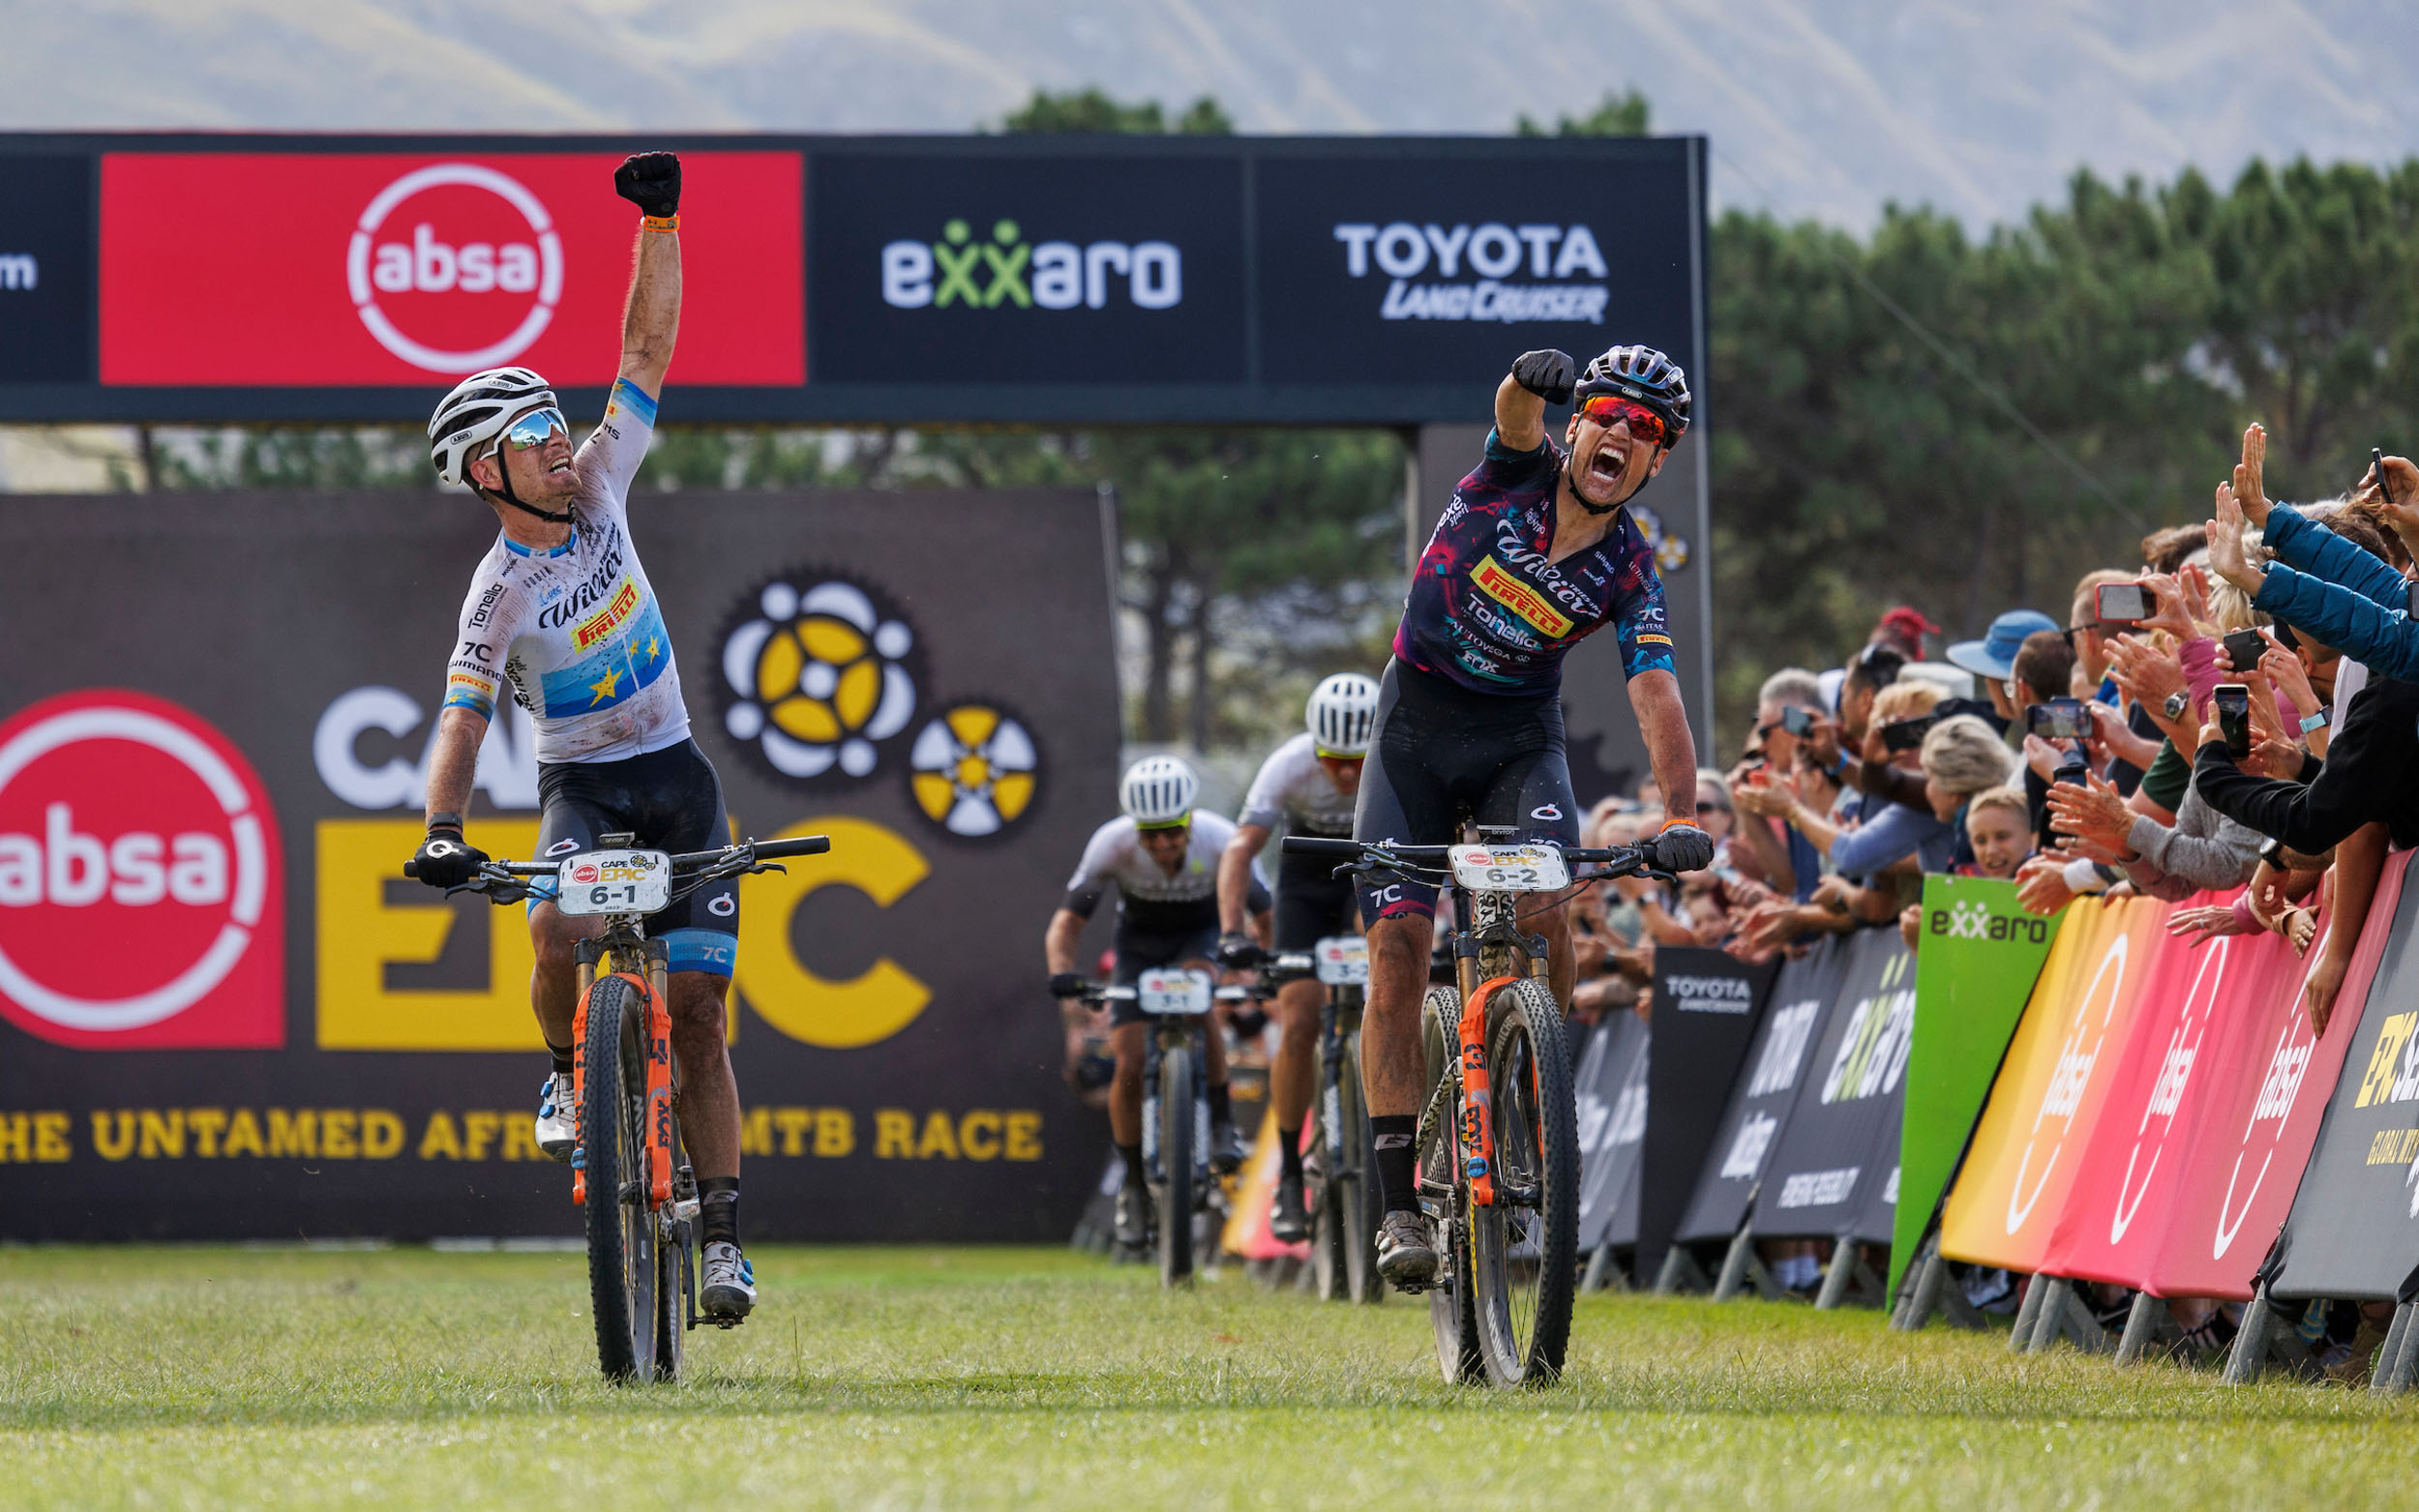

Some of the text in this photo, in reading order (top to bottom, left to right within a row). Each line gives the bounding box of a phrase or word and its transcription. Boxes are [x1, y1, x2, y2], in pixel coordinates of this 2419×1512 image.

[373, 222, 538, 293] absa
[881, 219, 1182, 310] exxaro
[1333, 221, 1609, 279] TOYOTA
[453, 432, 471, 444] ABUS
[538, 528, 623, 629] Wilier
[1479, 566, 1564, 634] PIRELLI
[467, 582, 503, 629] Tonello
[578, 584, 636, 647] PIRELLI
[1468, 593, 1539, 648] Tonello
[1639, 608, 1664, 622] 7C
[463, 641, 493, 664] 7C
[1450, 621, 1511, 661] AUTOVEGA
[449, 660, 503, 681] IMANO
[314, 685, 539, 810] CA
[0, 802, 228, 908] absa
[577, 870, 595, 878] absa
[600, 868, 647, 882] EPIC
[601, 860, 629, 869] CAPE
[1486, 868, 1539, 883] 6-2
[1494, 856, 1541, 866] EPIC
[589, 885, 636, 904] 6-1
[1369, 884, 1402, 908] 7C
[314, 815, 935, 1052] EC
[1930, 900, 2048, 944] exxaro
[701, 945, 729, 963] 7C
[1665, 975, 1752, 999] TOYOTA
[2151, 1017, 2195, 1115] absa
[2256, 1013, 2308, 1120] absa
[2353, 1010, 2419, 1109] EPIC SE
[0, 1111, 72, 1162] HE
[90, 1109, 404, 1161] UNTAMED
[737, 1108, 856, 1161] MTB
[874, 1108, 1043, 1161] RACE
[1465, 1103, 1483, 1154] FOX
[2366, 1129, 2405, 1166] GLOBAL
